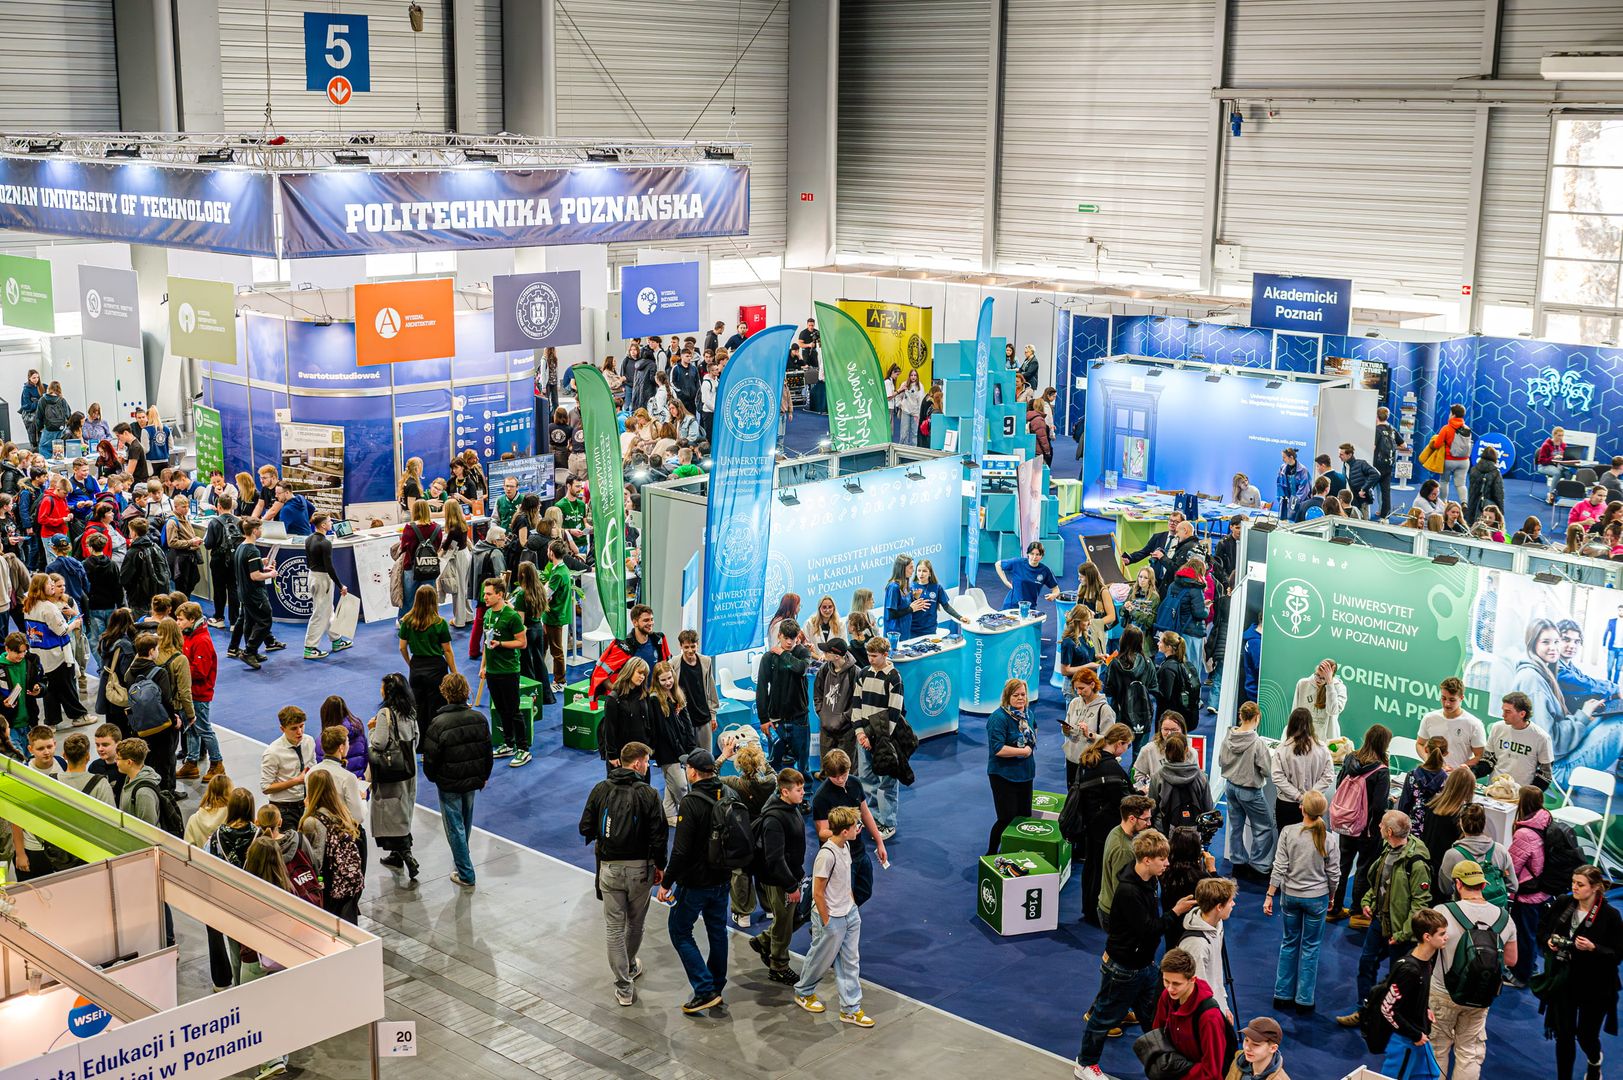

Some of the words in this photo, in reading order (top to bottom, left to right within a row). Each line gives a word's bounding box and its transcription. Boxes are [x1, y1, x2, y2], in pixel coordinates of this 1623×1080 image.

[325, 24, 352, 69] 5
[41, 187, 118, 214] UNIVERSITY
[121, 194, 137, 215] OF
[140, 195, 232, 224] TECHNOLOGY
[345, 199, 553, 233] POLITECHNIKA
[560, 188, 704, 225] POZNAŃSKA
[1263, 286, 1338, 304] Akademicki
[1275, 305, 1323, 321] Poznań
[1003, 416, 1014, 436] 9
[415, 557, 438, 566] VANS
[807, 547, 869, 570] UNIWERSYTET
[870, 537, 916, 556] MEDYCZNY
[824, 565, 860, 581] KAROLA
[711, 589, 763, 602] UNIWERSYTET
[818, 575, 864, 596] POZNANIU
[283, 599, 310, 613] UNIVERSITY
[714, 599, 758, 612] MEDYCZNY
[1332, 592, 1415, 619] UNIWERSYTET
[1302, 614, 1311, 622] 26
[1332, 609, 1419, 637] EKONOMICZNY
[1331, 626, 1343, 638] W
[1345, 629, 1408, 652] POZNANIU
[974, 638, 984, 706] www.ump.edu.pl
[1374, 695, 1401, 716] NA
[1510, 742, 1533, 756] UEP
[83, 1035, 164, 1079] Edukacji
[169, 1032, 175, 1048] i
[180, 1007, 240, 1043] Terapii
[396, 1031, 412, 1042] 20
[159, 1062, 177, 1079] w
[183, 1030, 263, 1071] Poznaniu
